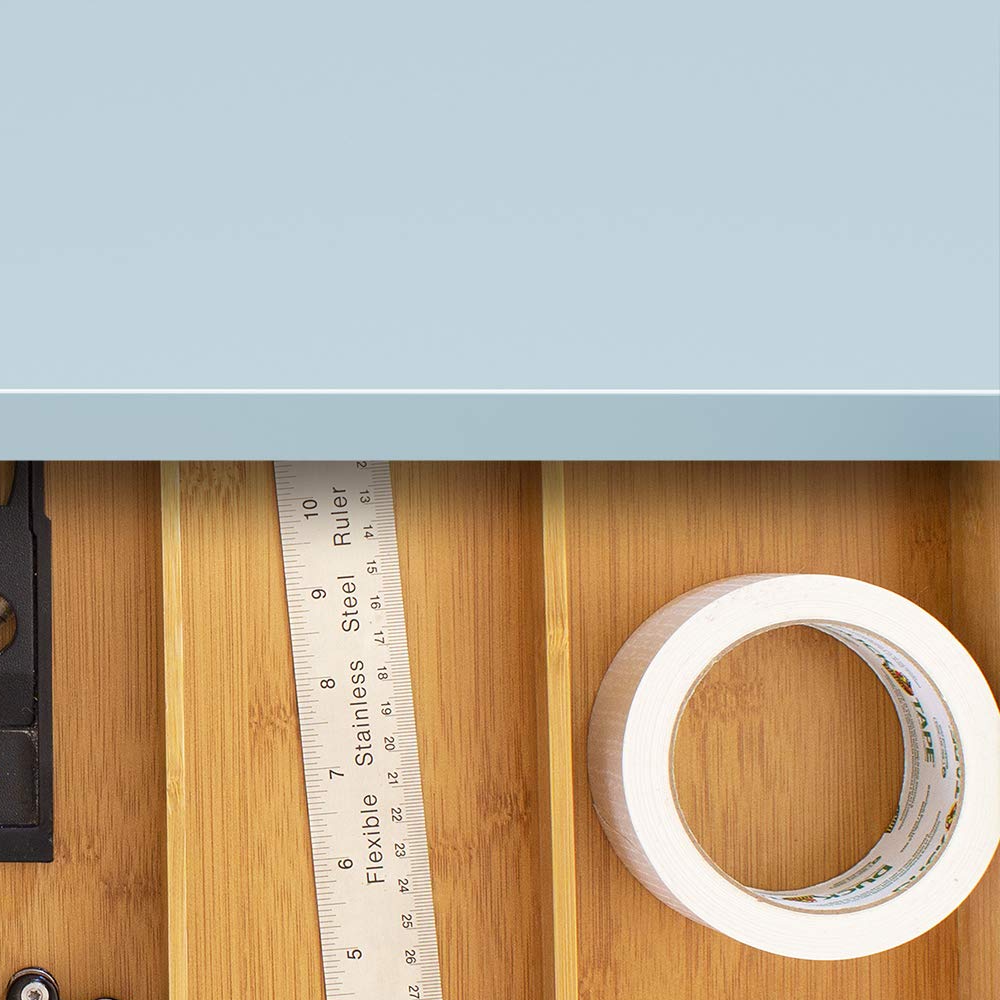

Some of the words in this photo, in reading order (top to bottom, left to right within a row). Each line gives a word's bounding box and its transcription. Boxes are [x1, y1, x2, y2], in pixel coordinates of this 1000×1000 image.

[360, 489, 370, 503] 13
[302, 499, 319, 520] 10
[331, 487, 351, 546] Ruler
[363, 525, 374, 538] 14
[366, 560, 377, 574] 15
[311, 589, 327, 600] 9
[337, 575, 360, 632] Steel
[370, 595, 381, 609] 16
[373, 631, 384, 644] 17
[377, 666, 388, 680] 18
[320, 679, 335, 689] 8
[349, 659, 374, 767] Stainless
[380, 701, 392, 715] 19
[911, 699, 935, 763] TAPE
[384, 736, 395, 751] 20
[329, 769, 344, 779] 7
[388, 771, 399, 784] 21
[391, 807, 402, 822] 22
[360, 794, 385, 883] Flexible
[394, 843, 406, 857] 23
[337, 859, 354, 869] 6
[398, 878, 409, 893] 24
[819, 864, 893, 902] DUCK
[401, 914, 413, 928] 25
[347, 949, 362, 959] 5
[405, 950, 417, 964] 26
[409, 985, 420, 999] 27
